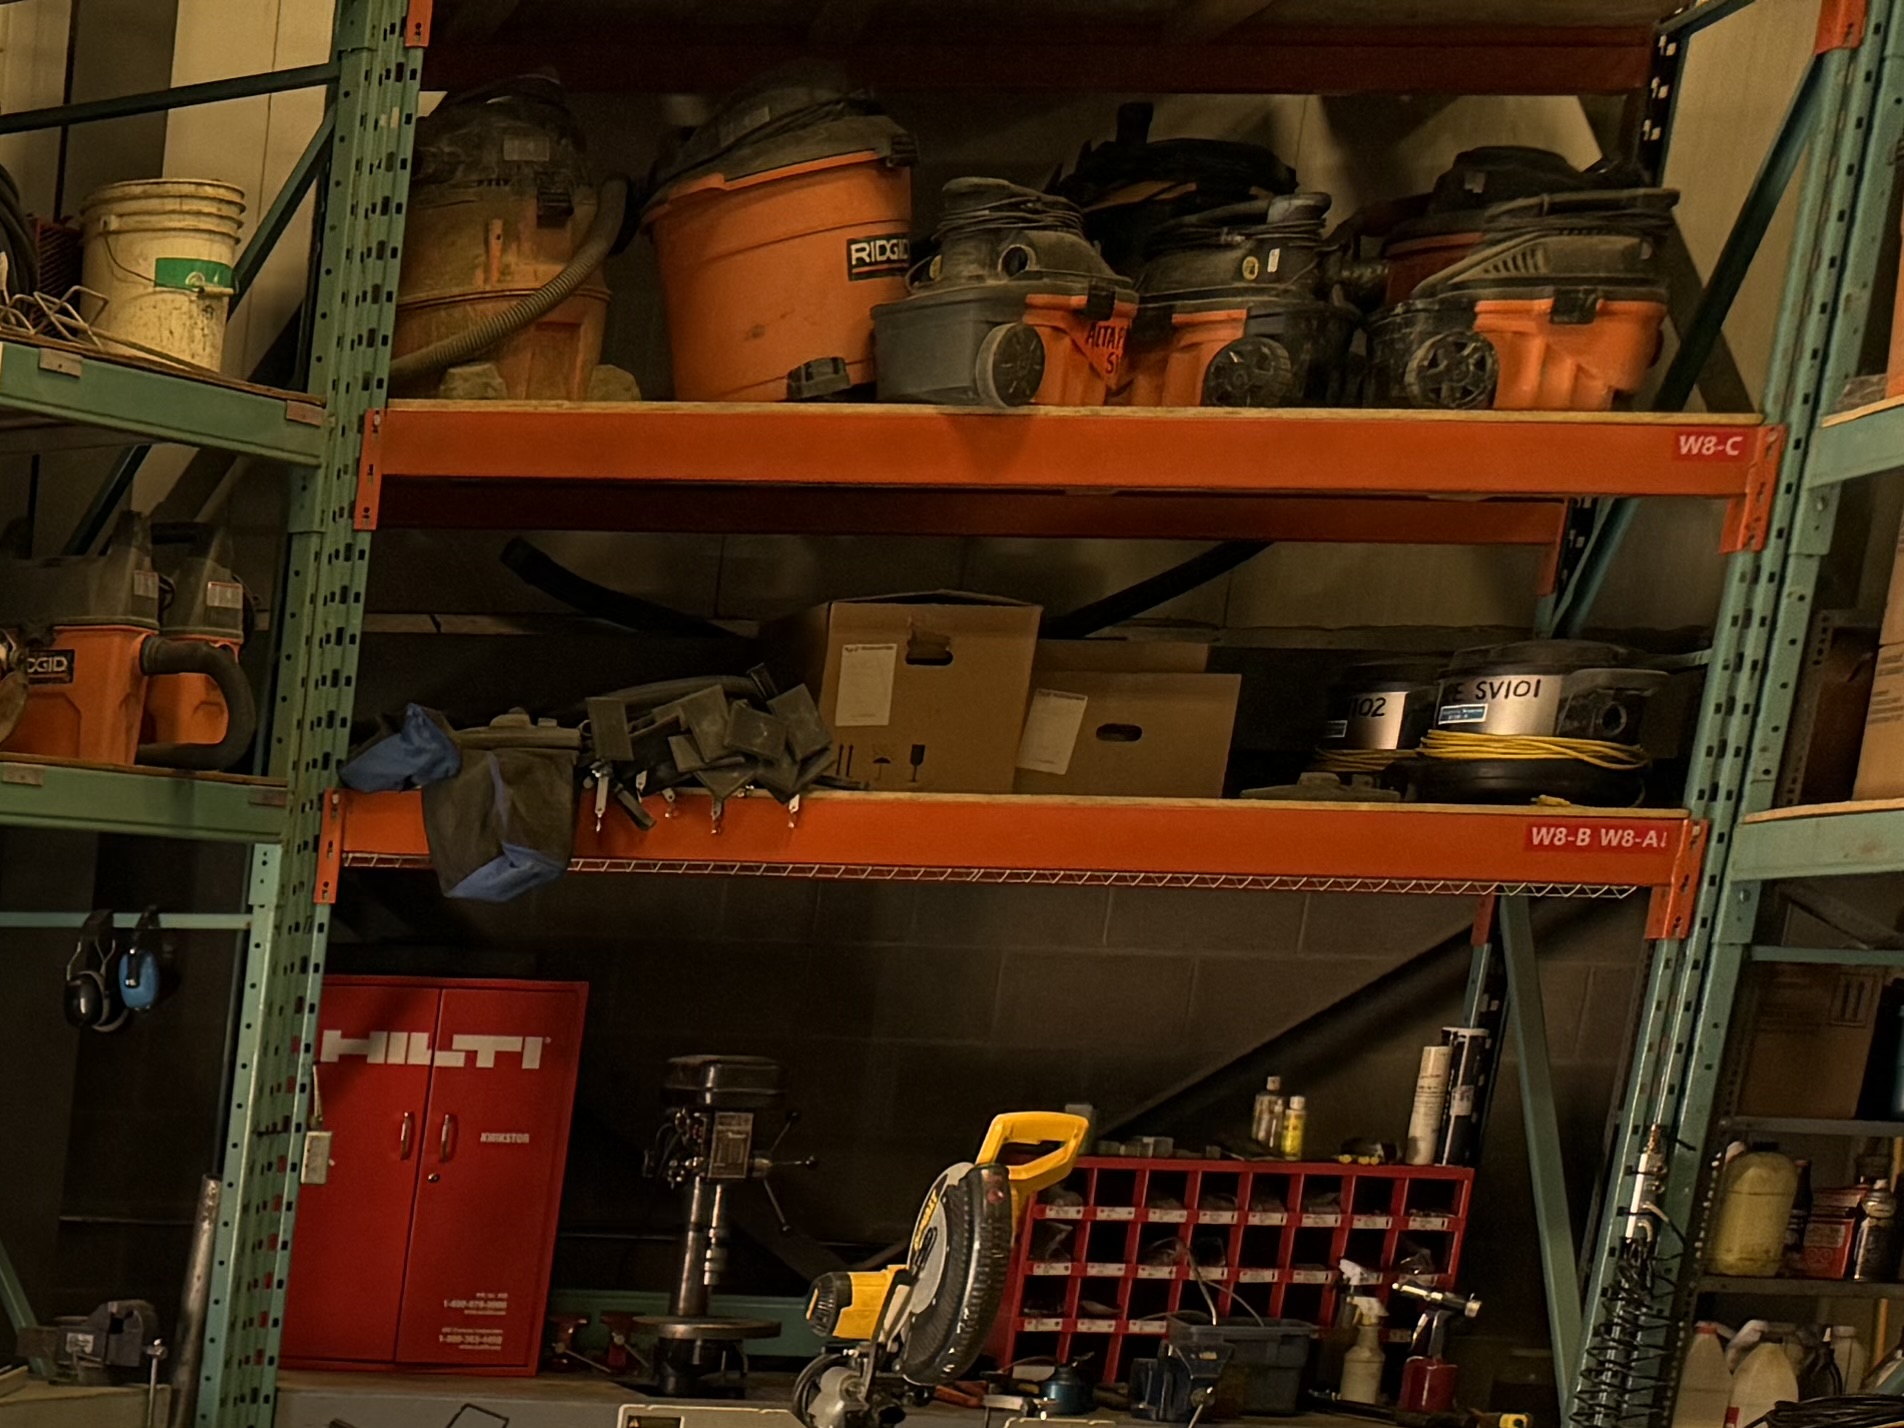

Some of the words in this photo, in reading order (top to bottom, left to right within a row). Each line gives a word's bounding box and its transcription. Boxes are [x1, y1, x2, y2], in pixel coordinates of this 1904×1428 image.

[1679, 435, 1743, 456] W8-C
[26, 657, 68, 674] DGID
[1531, 826, 1591, 847] W8-B
[320, 1029, 544, 1070] HILTI
